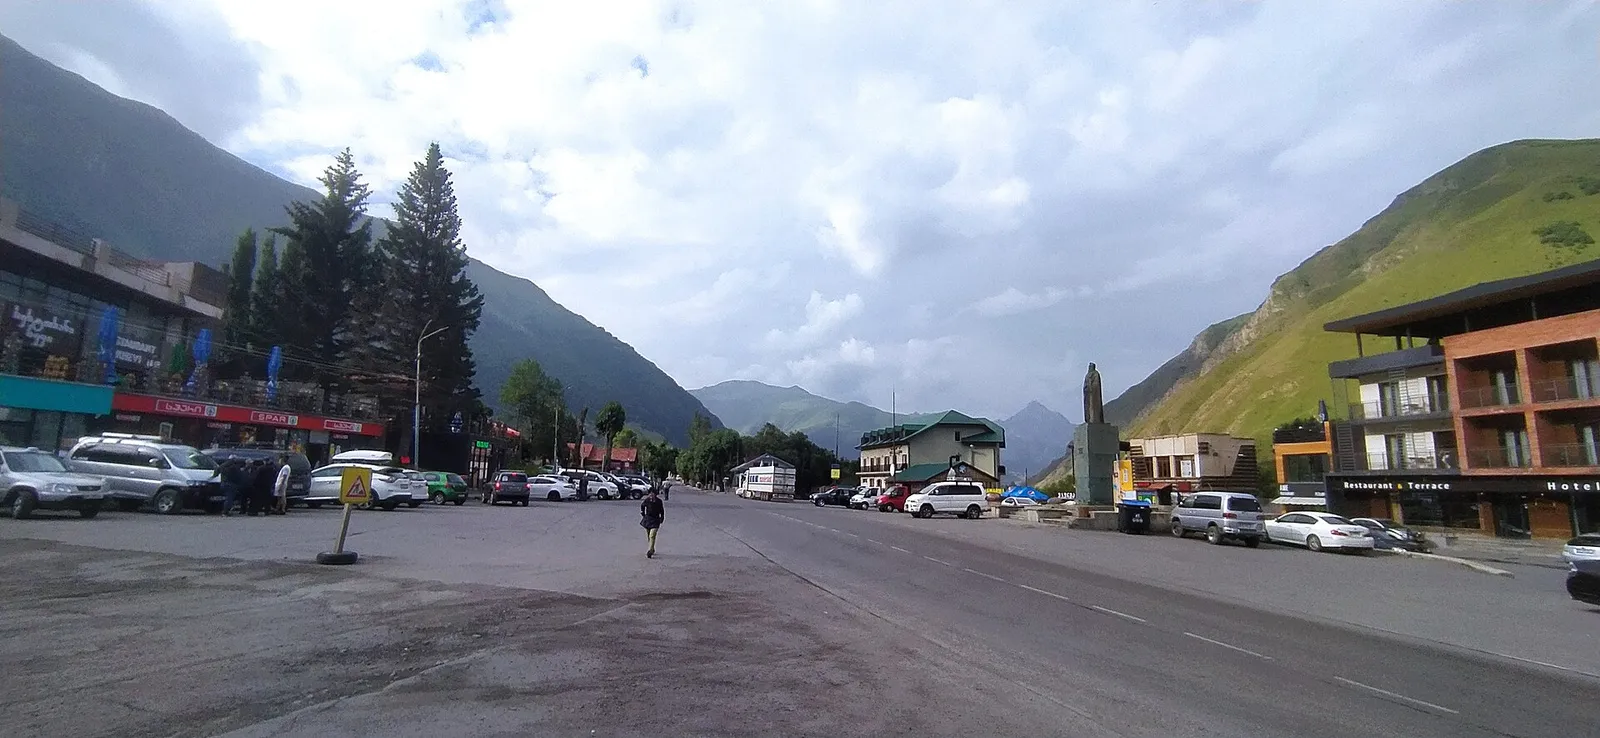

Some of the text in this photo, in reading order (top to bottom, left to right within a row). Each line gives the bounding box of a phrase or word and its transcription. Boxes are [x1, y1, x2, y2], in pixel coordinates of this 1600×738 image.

[258, 413, 287, 423] SPAR
[1343, 481, 1393, 489] Restaurant
[1407, 482, 1450, 490] Terrace
[1547, 481, 1600, 491] Hotel
